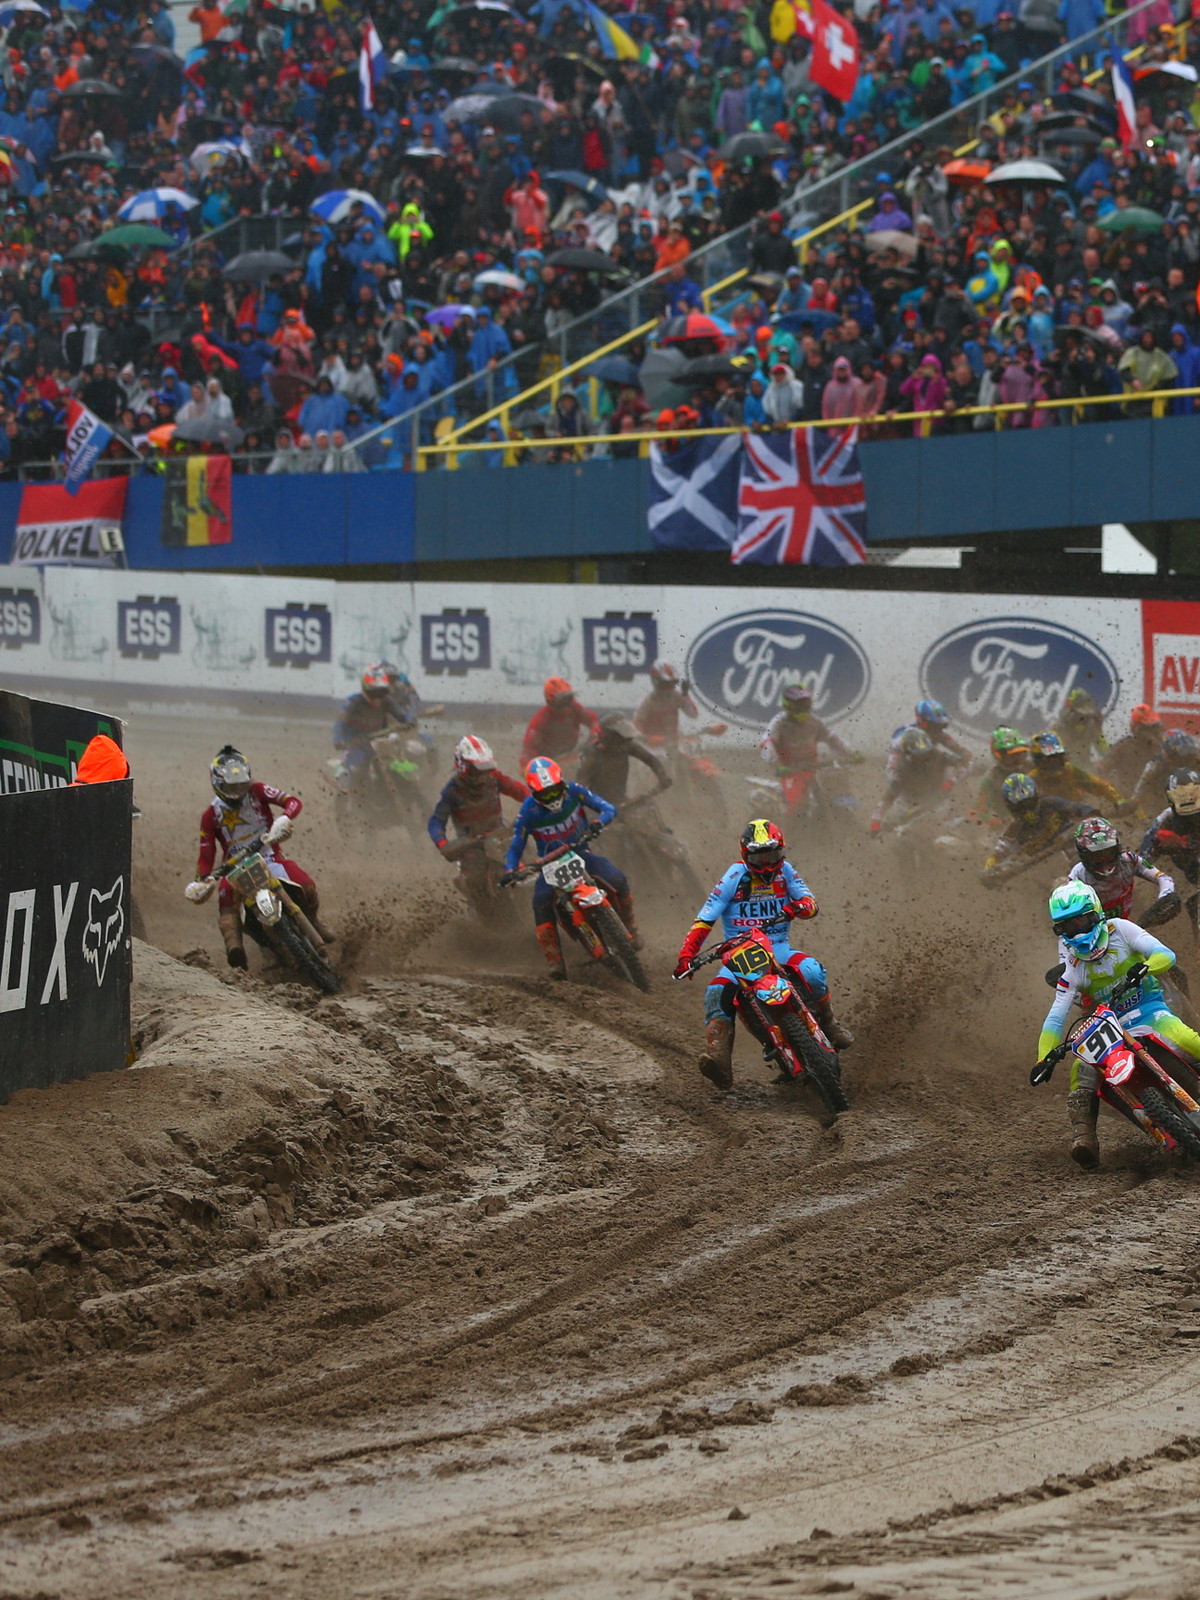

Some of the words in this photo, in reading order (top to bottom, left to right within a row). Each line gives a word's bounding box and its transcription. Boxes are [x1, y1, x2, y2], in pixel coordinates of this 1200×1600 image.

[126, 608, 171, 646] ESS
[274, 616, 321, 654] ESS
[430, 622, 480, 662] ESS
[594, 626, 646, 666] ESS
[722, 628, 834, 708] Ford
[959, 636, 1079, 723] Ford
[739, 899, 785, 918] KENNY
[0, 882, 79, 1014] OX
[732, 944, 769, 976] 16
[1085, 1022, 1119, 1062] 91
